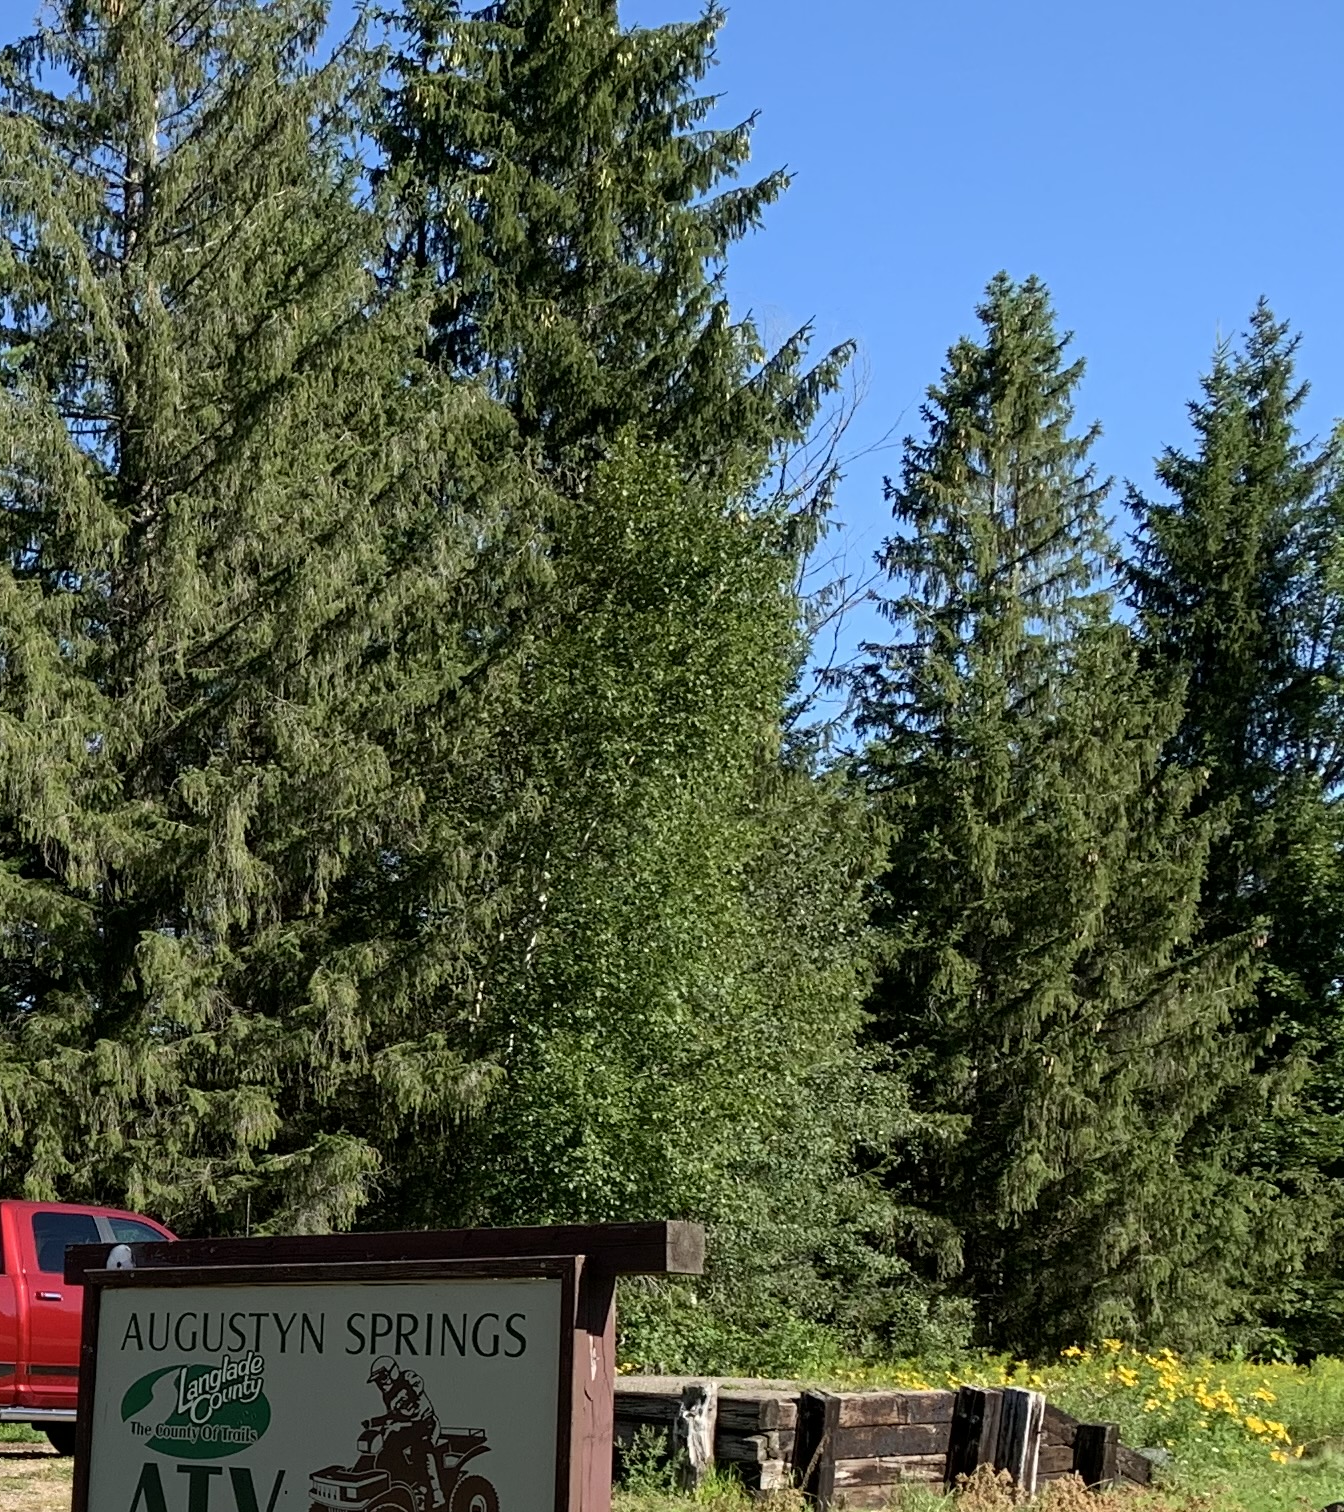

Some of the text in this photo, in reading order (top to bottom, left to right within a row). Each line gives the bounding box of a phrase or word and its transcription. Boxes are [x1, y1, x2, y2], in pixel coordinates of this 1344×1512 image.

[121, 1312, 527, 1358] AUGUSTYN SPRINGS
[178, 1351, 264, 1414] Langlade
[190, 1375, 263, 1424] County
[130, 1421, 258, 1443] The County Of Trails
